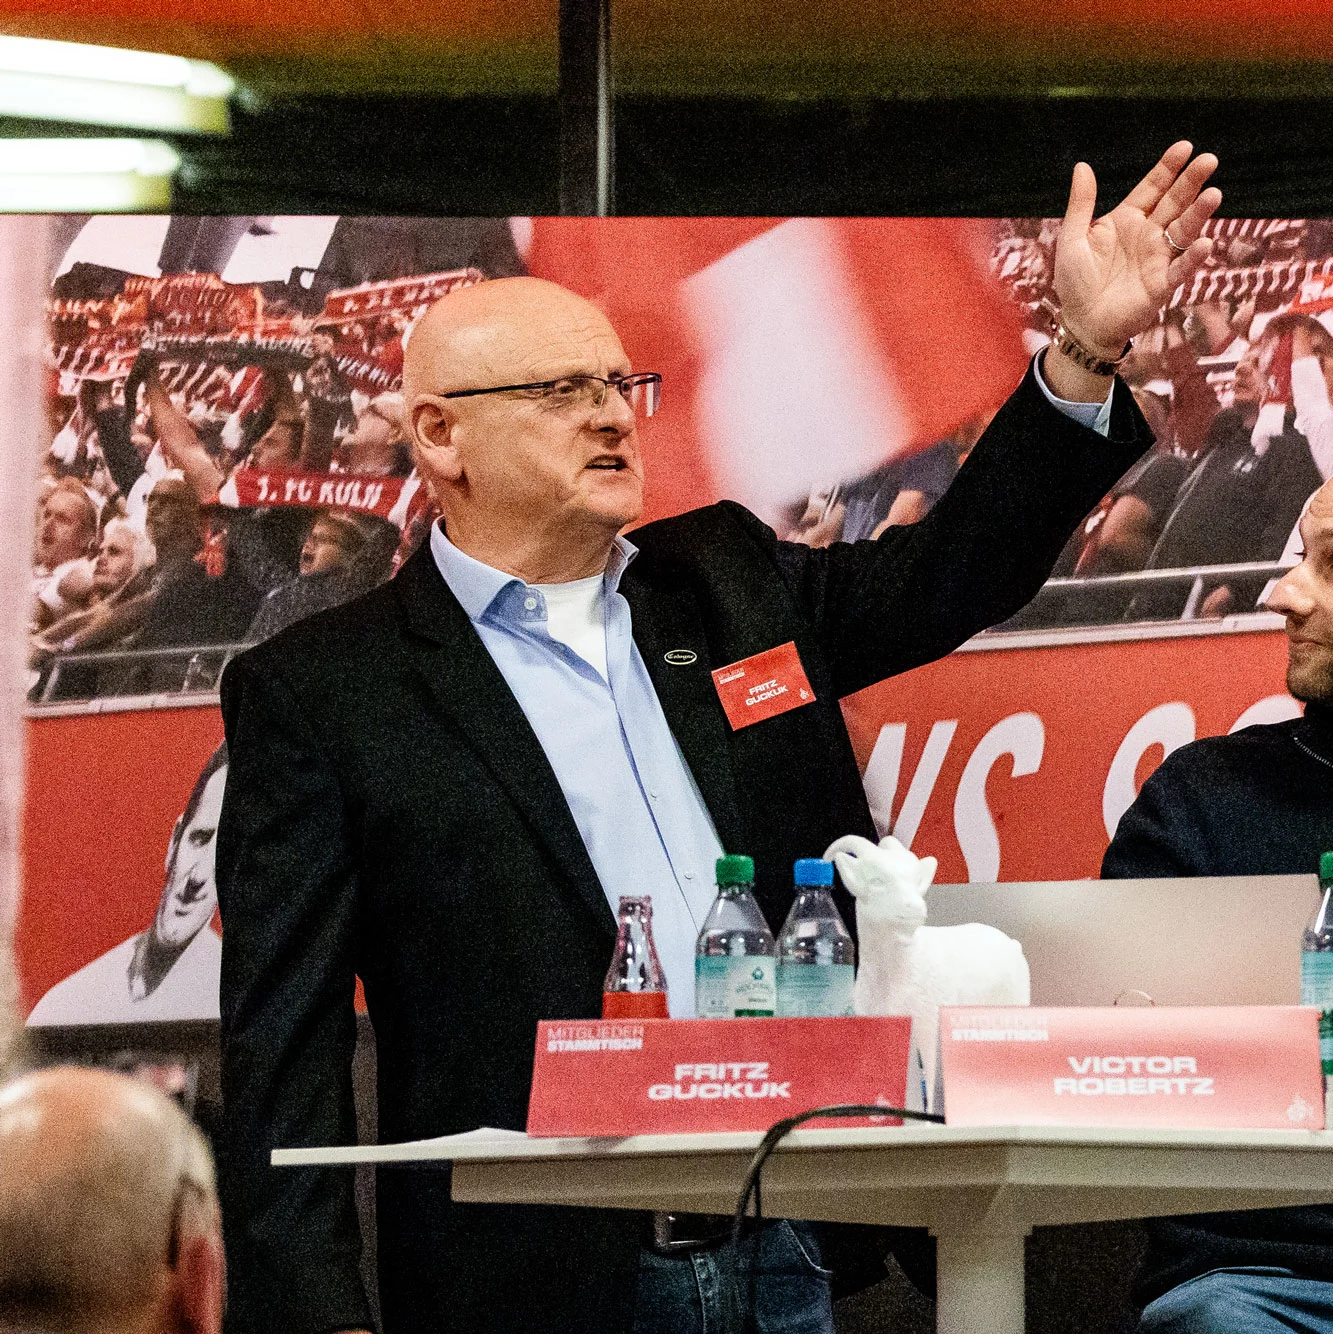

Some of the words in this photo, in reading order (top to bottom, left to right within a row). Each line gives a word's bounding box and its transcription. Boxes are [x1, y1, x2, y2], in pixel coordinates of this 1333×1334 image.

[745, 685, 788, 706] GUCKUK
[749, 679, 778, 696] FRITZ
[674, 1061, 769, 1081] FRITZ
[1067, 1056, 1198, 1074] VICTOR
[647, 1081, 791, 1100] GUCKUK
[1053, 1077, 1216, 1096] ROBERTZ
